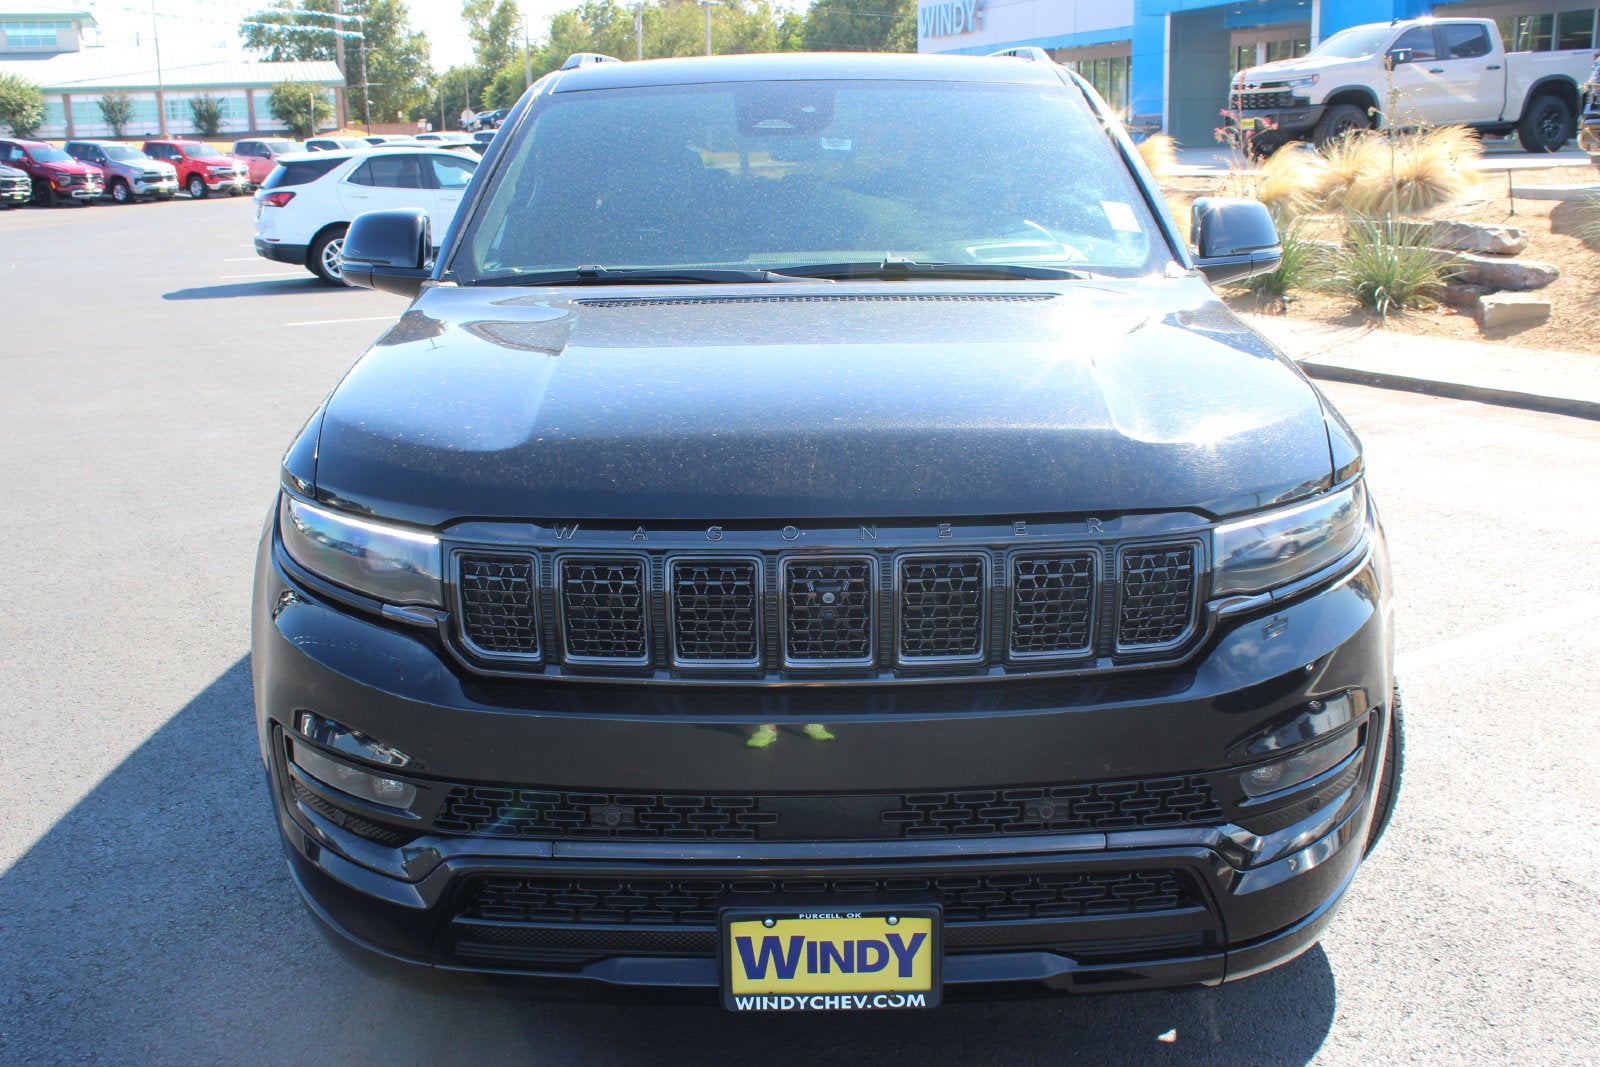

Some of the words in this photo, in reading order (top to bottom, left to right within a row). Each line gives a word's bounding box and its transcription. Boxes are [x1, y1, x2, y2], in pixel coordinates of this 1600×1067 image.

[921, 0, 976, 38] WINDY
[553, 517, 1104, 542] WAGONEER
[735, 932, 928, 980] WINDY
[735, 994, 926, 1011] WINDYCHEV.COM
